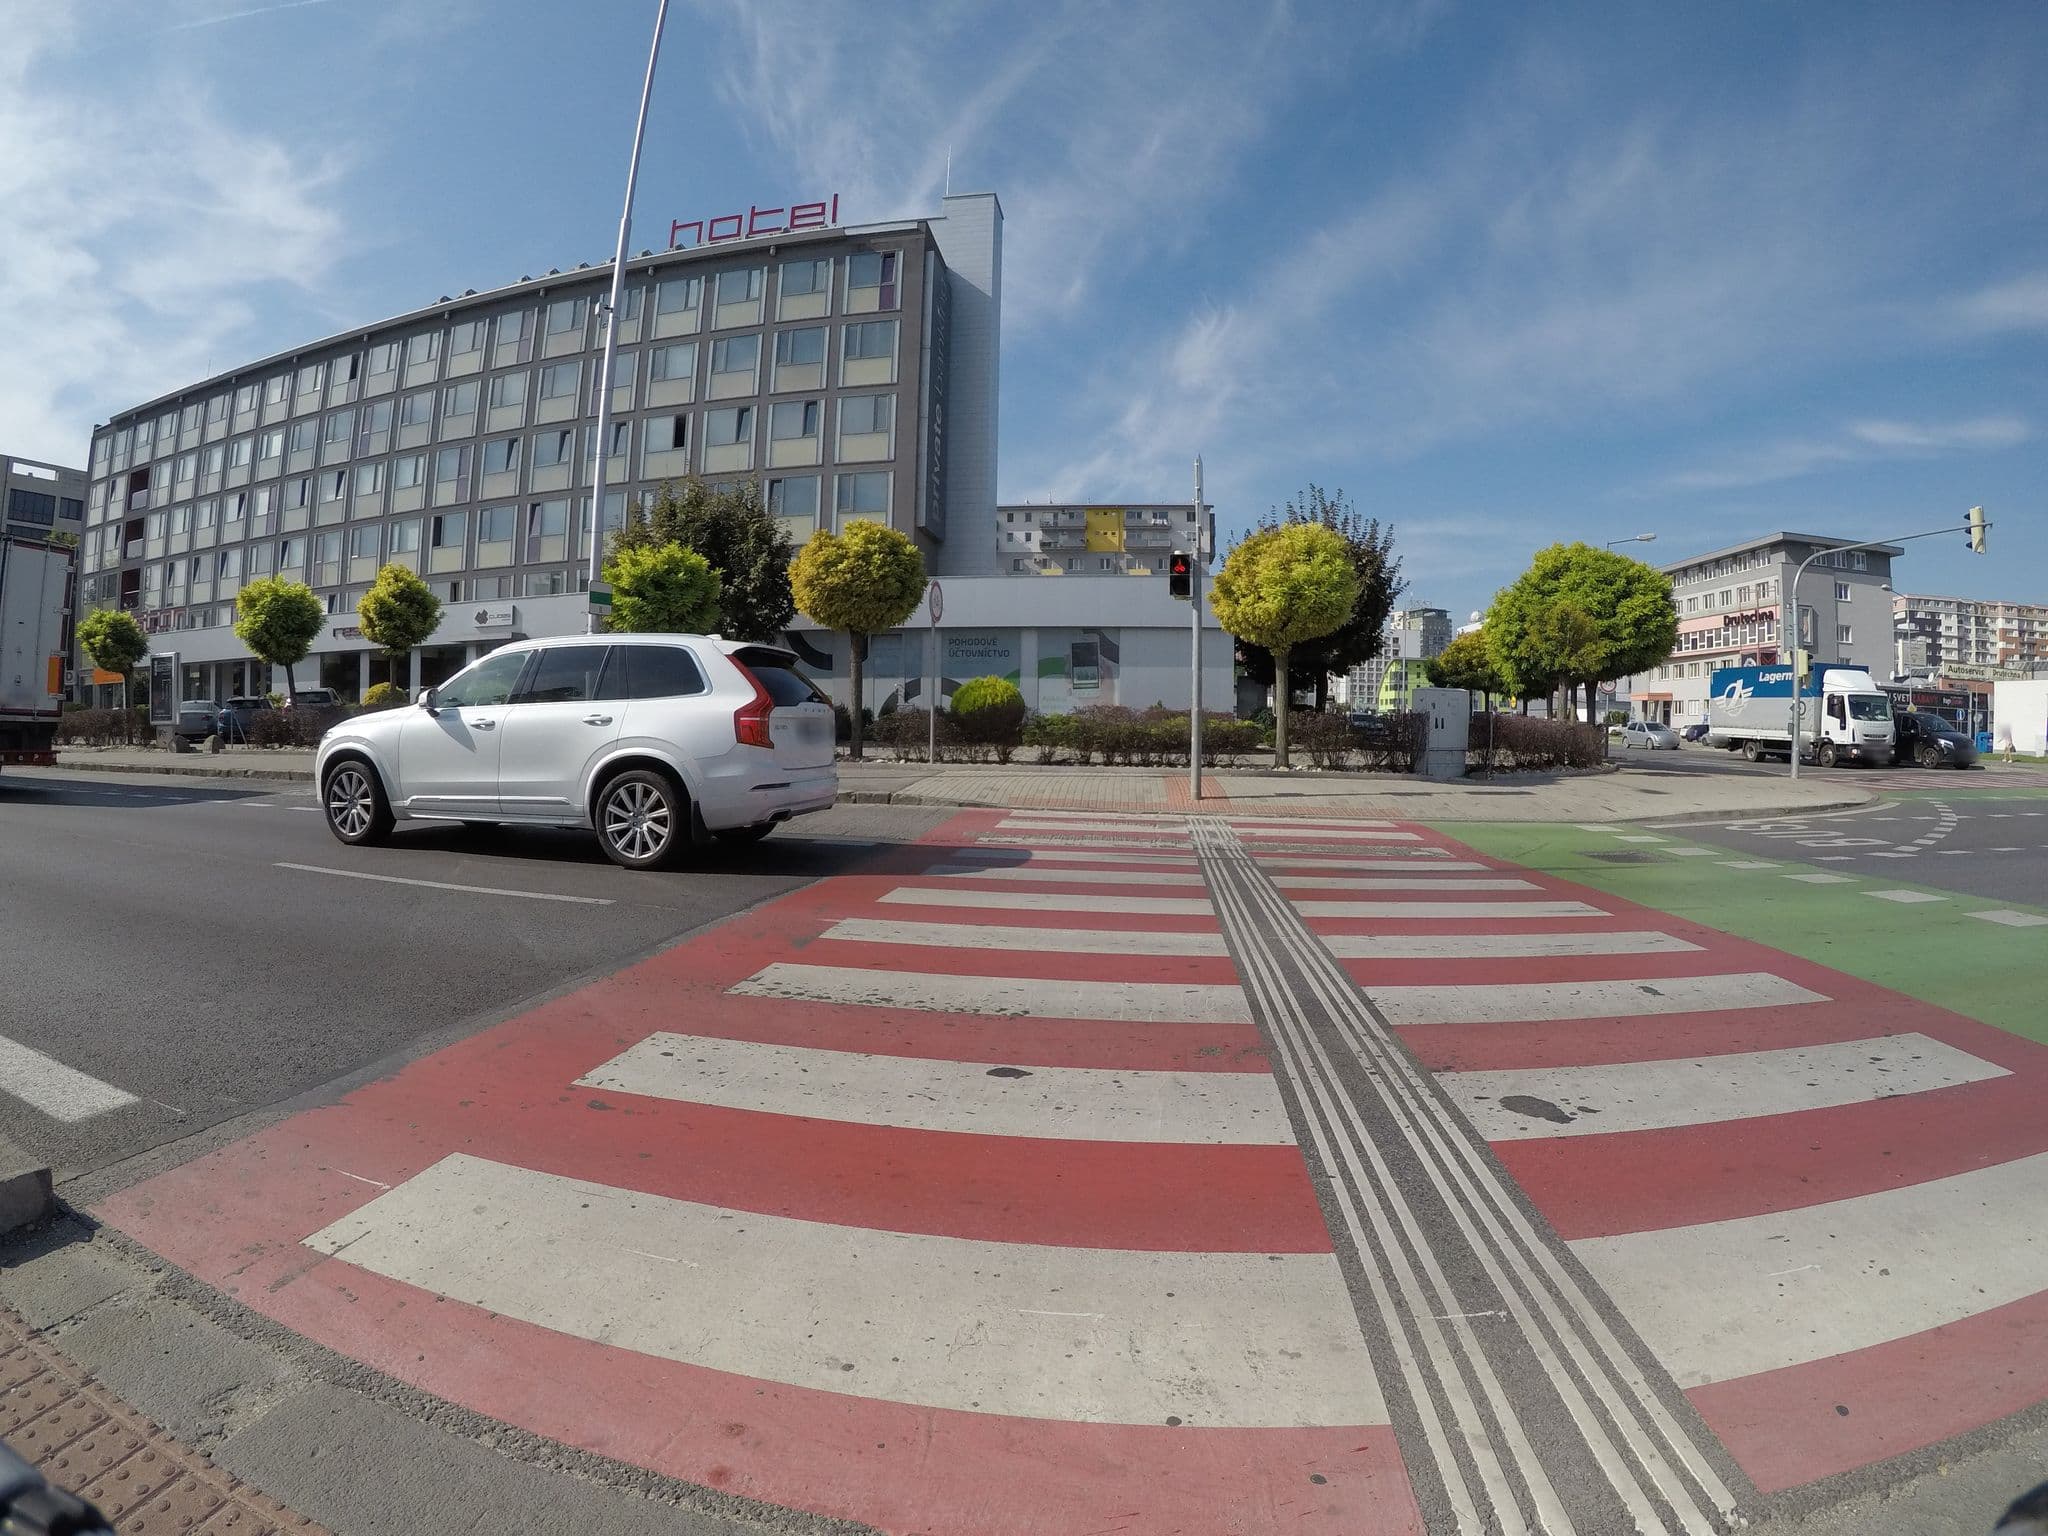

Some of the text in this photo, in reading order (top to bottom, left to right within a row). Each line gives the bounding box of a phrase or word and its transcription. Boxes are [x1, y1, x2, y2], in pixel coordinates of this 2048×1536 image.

[669, 193, 838, 249] hotel
[1758, 671, 1794, 684] Lagerm
[1947, 665, 1984, 676] Autoservis
[1724, 823, 1897, 848] BUS
